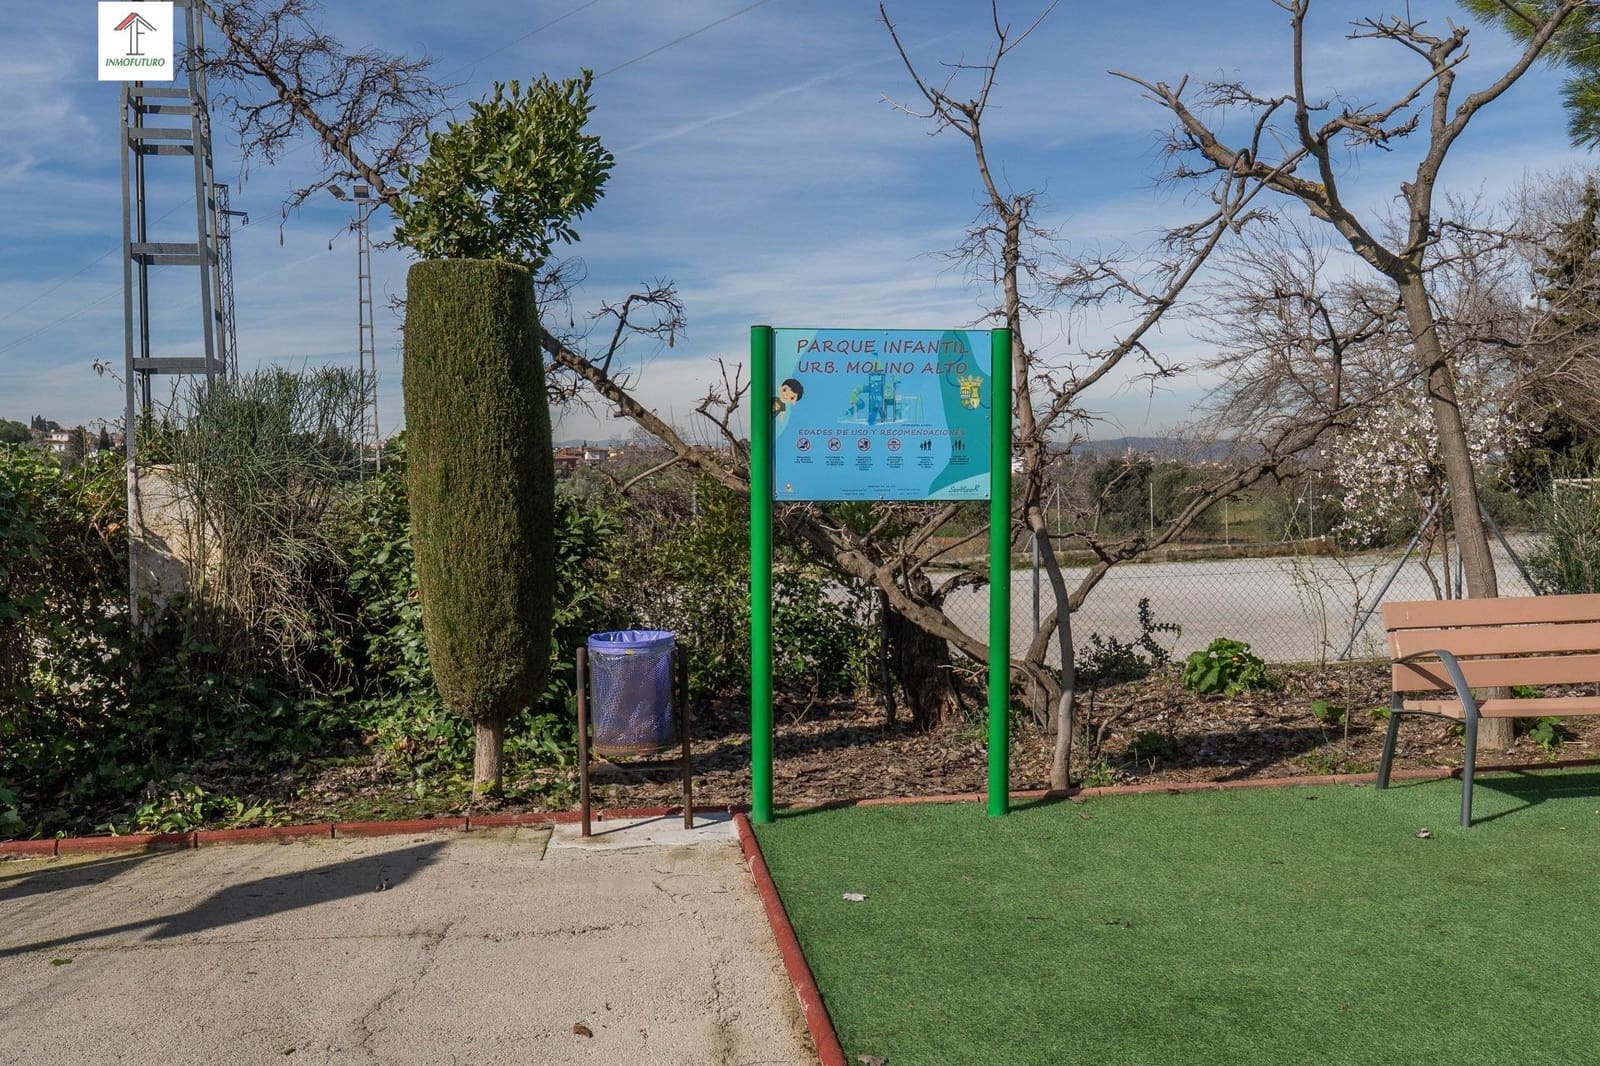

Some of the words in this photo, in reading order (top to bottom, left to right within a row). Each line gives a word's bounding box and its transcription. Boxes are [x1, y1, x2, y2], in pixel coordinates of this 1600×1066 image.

[797, 339, 876, 354] PARQUE
[883, 339, 969, 354] INFANTIL
[797, 361, 839, 374] URB.
[846, 361, 915, 374] MOLINO
[921, 361, 968, 374] ALTO
